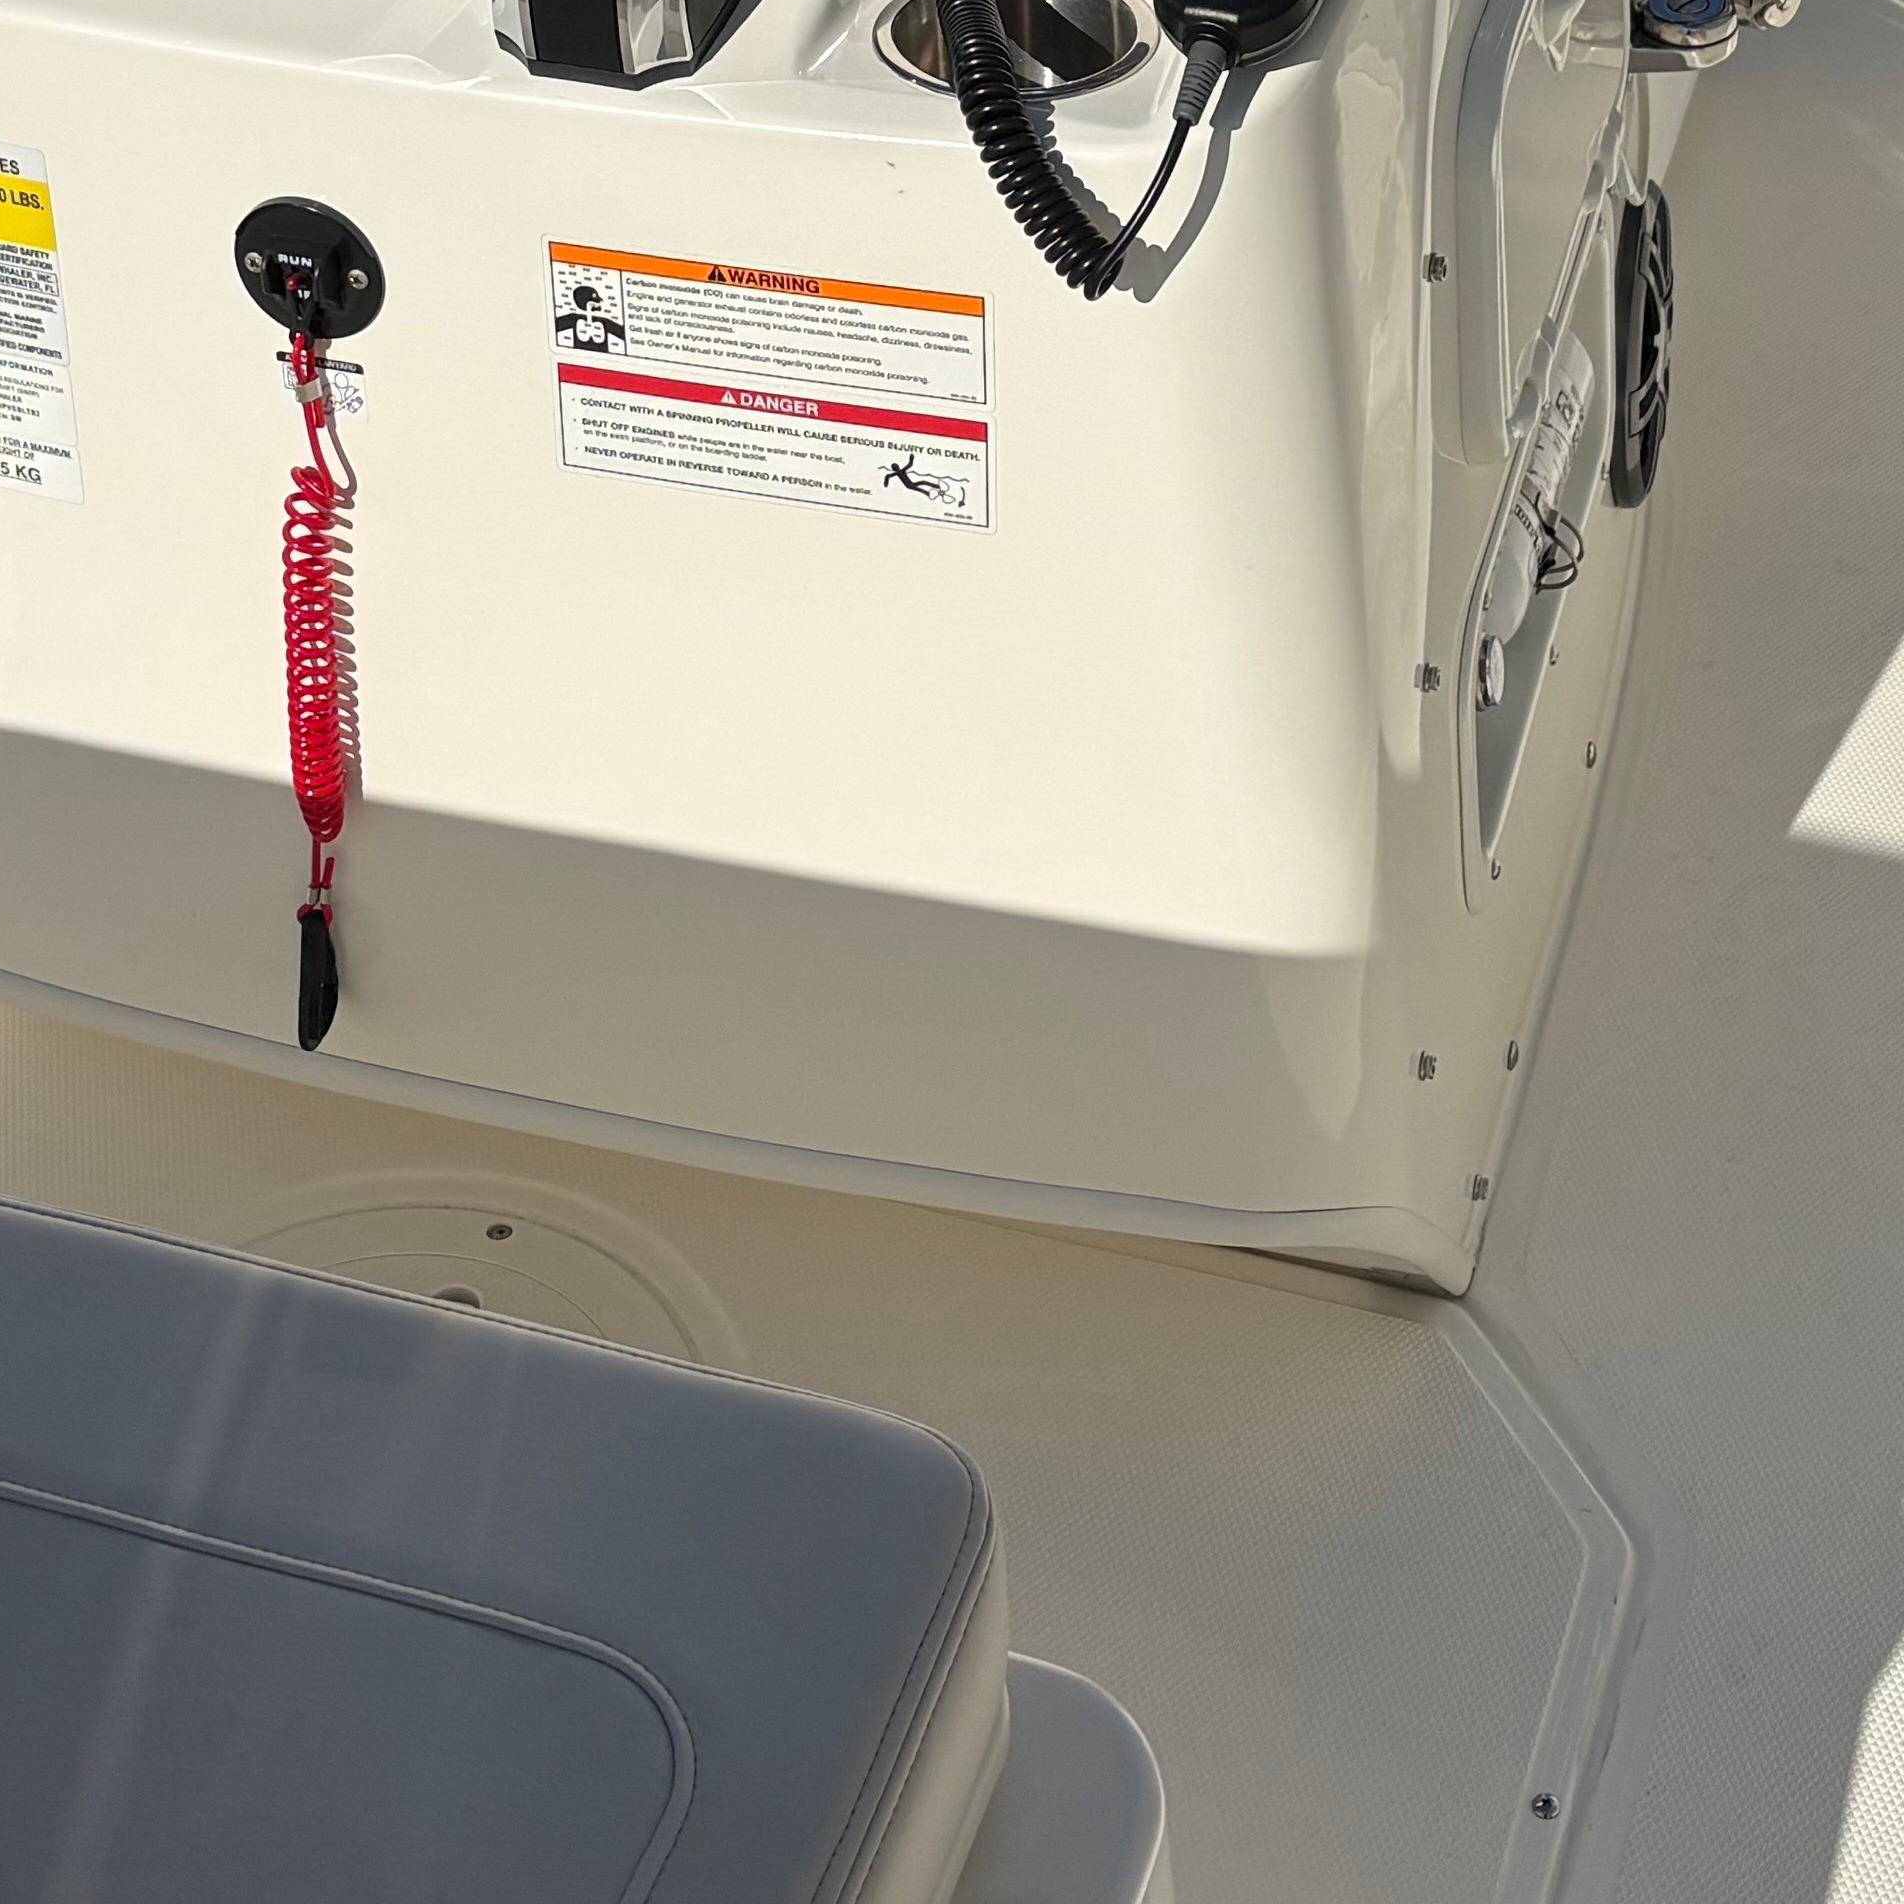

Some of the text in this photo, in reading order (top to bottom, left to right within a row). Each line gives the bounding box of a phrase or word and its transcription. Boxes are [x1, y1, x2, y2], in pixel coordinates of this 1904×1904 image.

[9, 189, 44, 210] LBS.
[277, 253, 313, 268] RUN
[727, 268, 820, 295] WARNING
[738, 390, 820, 417] DANGER
[15, 464, 41, 482] KG
